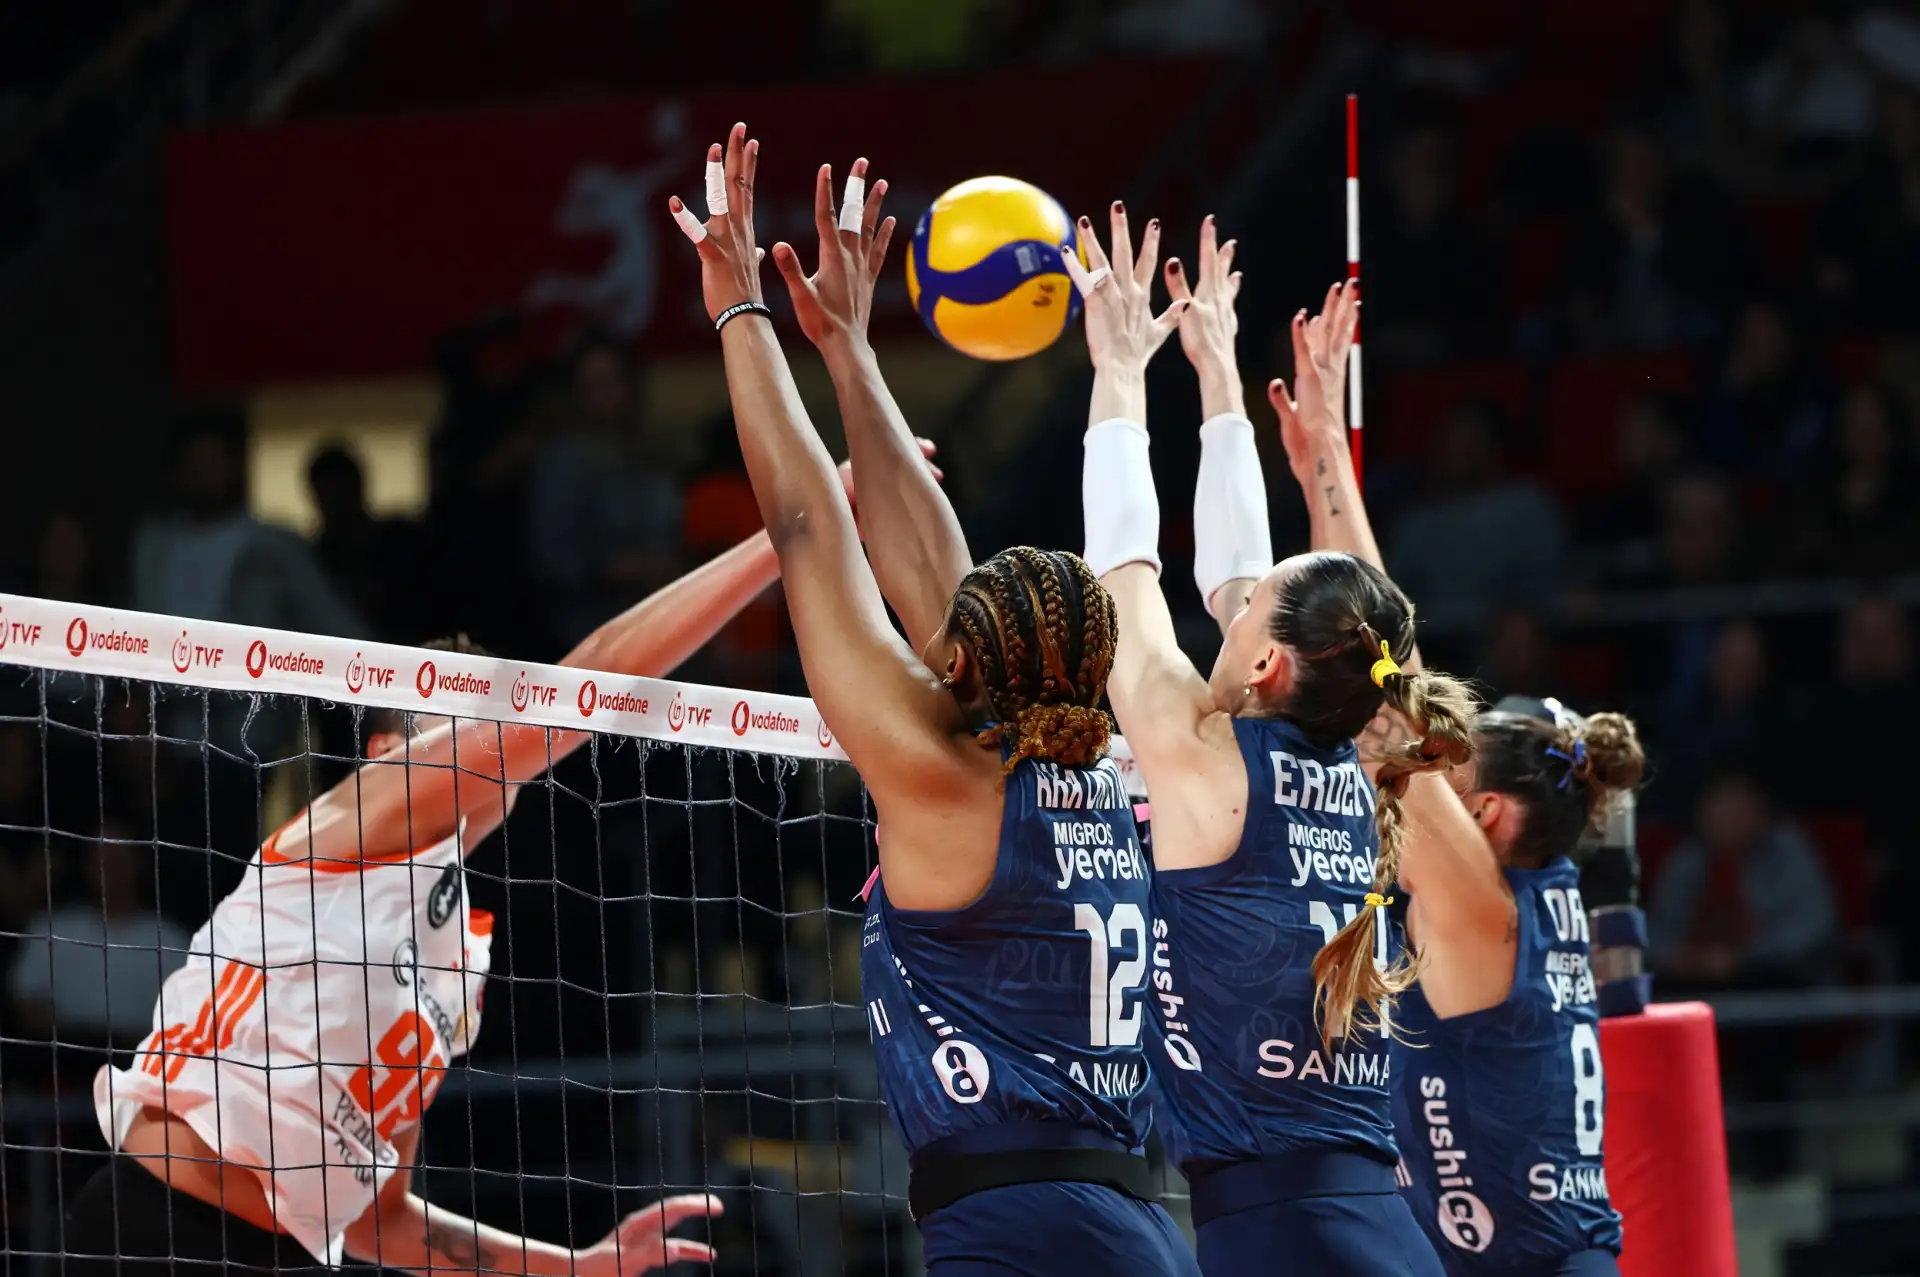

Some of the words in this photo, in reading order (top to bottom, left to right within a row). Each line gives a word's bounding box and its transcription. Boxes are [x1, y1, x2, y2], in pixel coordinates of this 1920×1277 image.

[12, 623, 42, 646] TVF
[90, 630, 149, 654] vodafone
[195, 645, 224, 669] TVF
[269, 652, 324, 676] vodafone
[368, 667, 395, 689] TVF
[438, 672, 491, 696] vodafone
[532, 685, 558, 707] TVF
[599, 693, 649, 716] vodafone
[688, 706, 712, 727] TVF
[751, 711, 800, 734] vodafone
[1053, 821, 1114, 846] MIGROS
[1288, 822, 1352, 853] MIGROS
[1055, 837, 1144, 890] yemek
[1074, 903, 1147, 1046] 12
[1570, 1023, 1605, 1156] 8
